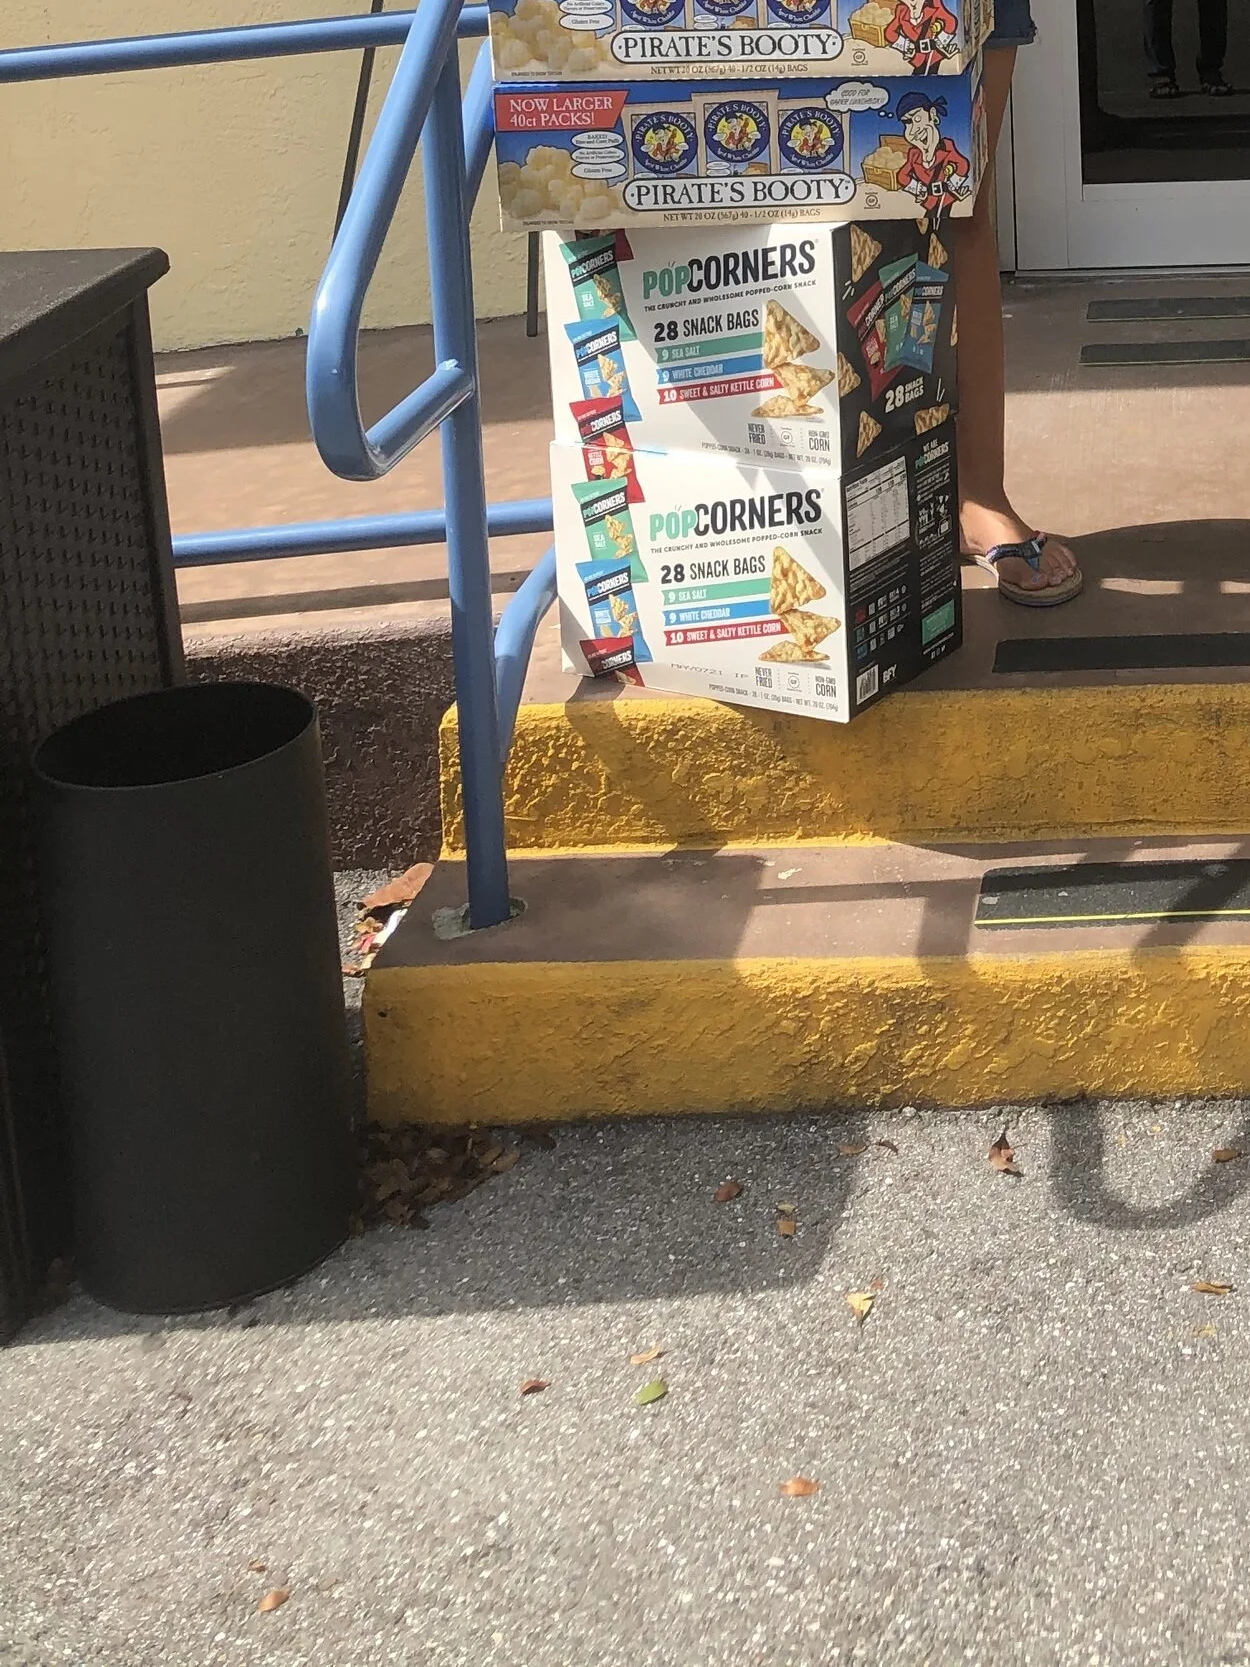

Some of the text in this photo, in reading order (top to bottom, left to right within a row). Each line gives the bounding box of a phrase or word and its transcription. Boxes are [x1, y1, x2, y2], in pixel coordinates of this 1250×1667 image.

[623, 33, 832, 59] PIRATE'S BOOTY
[510, 97, 612, 113] NOW LARGER
[510, 113, 595, 127] 40ct PACKS!
[636, 180, 845, 206] PIRATE'S BOOTY
[643, 239, 816, 300] POPCORNERS
[654, 309, 759, 342] 28 SNACK BAGS
[672, 345, 700, 358] SEA SALT
[672, 364, 724, 379] WHITE CHEDDAR
[663, 377, 774, 402] 10 SWEET SALTY KETTLE CORN
[885, 385, 904, 413] 28
[809, 438, 830, 452] CORN
[650, 488, 822, 542] POPCORNERS
[710, 537, 750, 547] WHOLESOME
[661, 555, 766, 584] 28 SNACK BAGS
[679, 590, 707, 602] SEA SALT
[679, 608, 730, 622] WHITE CHEDDAR
[670, 622, 781, 643] 10 SWEET SALTY KETTLE CORN
[816, 683, 837, 698] CORN
